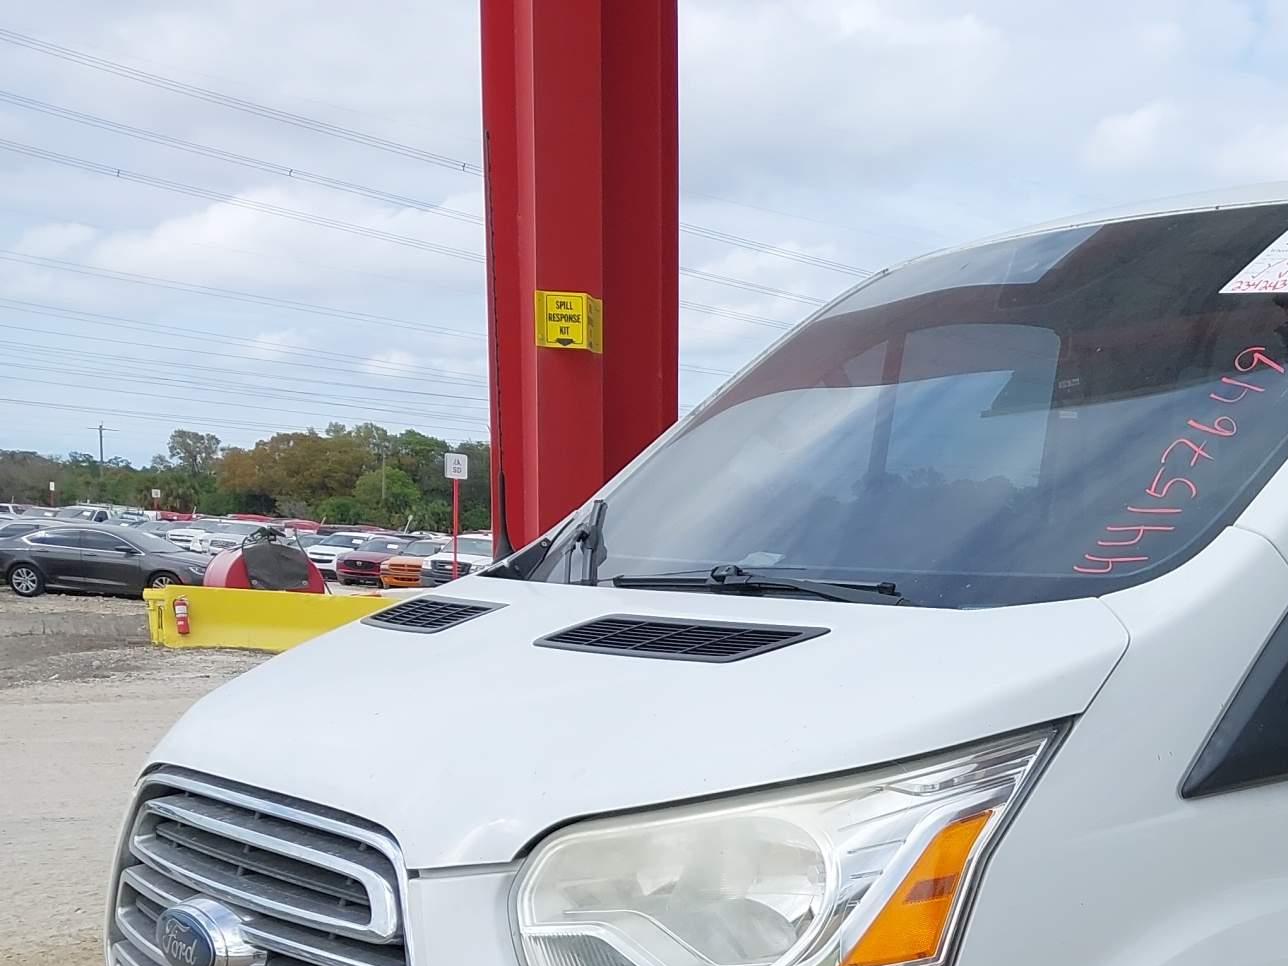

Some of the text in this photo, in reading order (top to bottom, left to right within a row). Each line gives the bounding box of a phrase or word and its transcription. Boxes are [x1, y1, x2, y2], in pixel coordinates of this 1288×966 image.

[555, 300, 573, 310] SPILL
[548, 312, 581, 323] RESPONSE
[559, 326, 570, 335] KIT
[1073, 347, 1285, 573] 44157649
[162, 918, 198, 965] Ford
